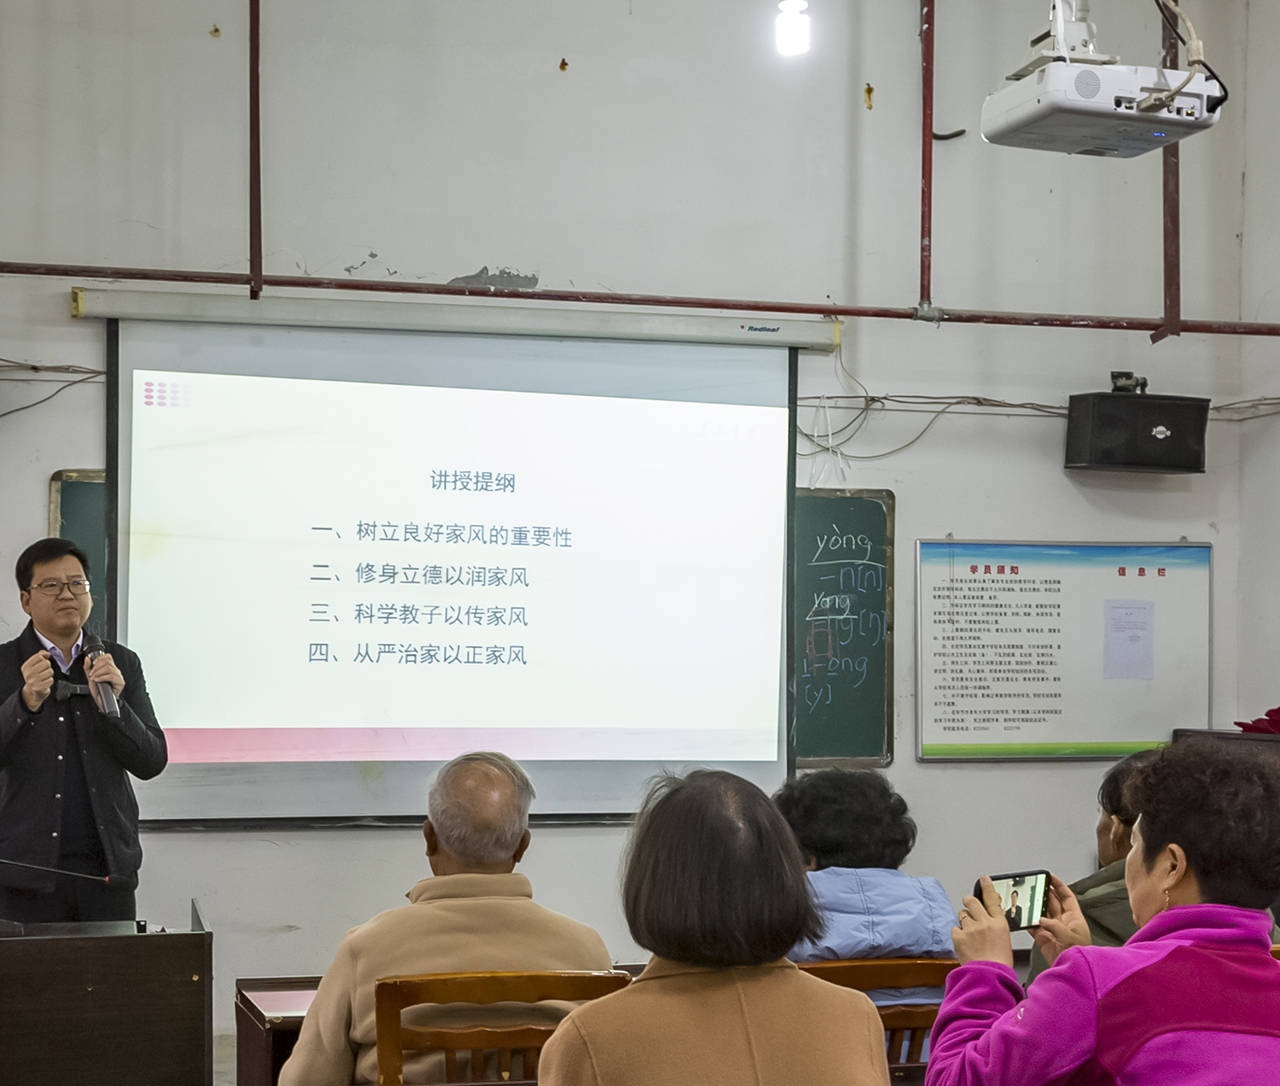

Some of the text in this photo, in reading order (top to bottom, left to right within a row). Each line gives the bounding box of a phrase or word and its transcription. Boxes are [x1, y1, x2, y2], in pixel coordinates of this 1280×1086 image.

[429, 469, 516, 494] 讲授提纲
[311, 520, 573, 548] 一、树立良好家风的重要性
[812, 523, 872, 562] yòng
[309, 561, 530, 588] 二、修身立德以润家风
[308, 602, 529, 627] 三、科学教子以传家风
[308, 642, 528, 666] 四、从严治家以正家风
